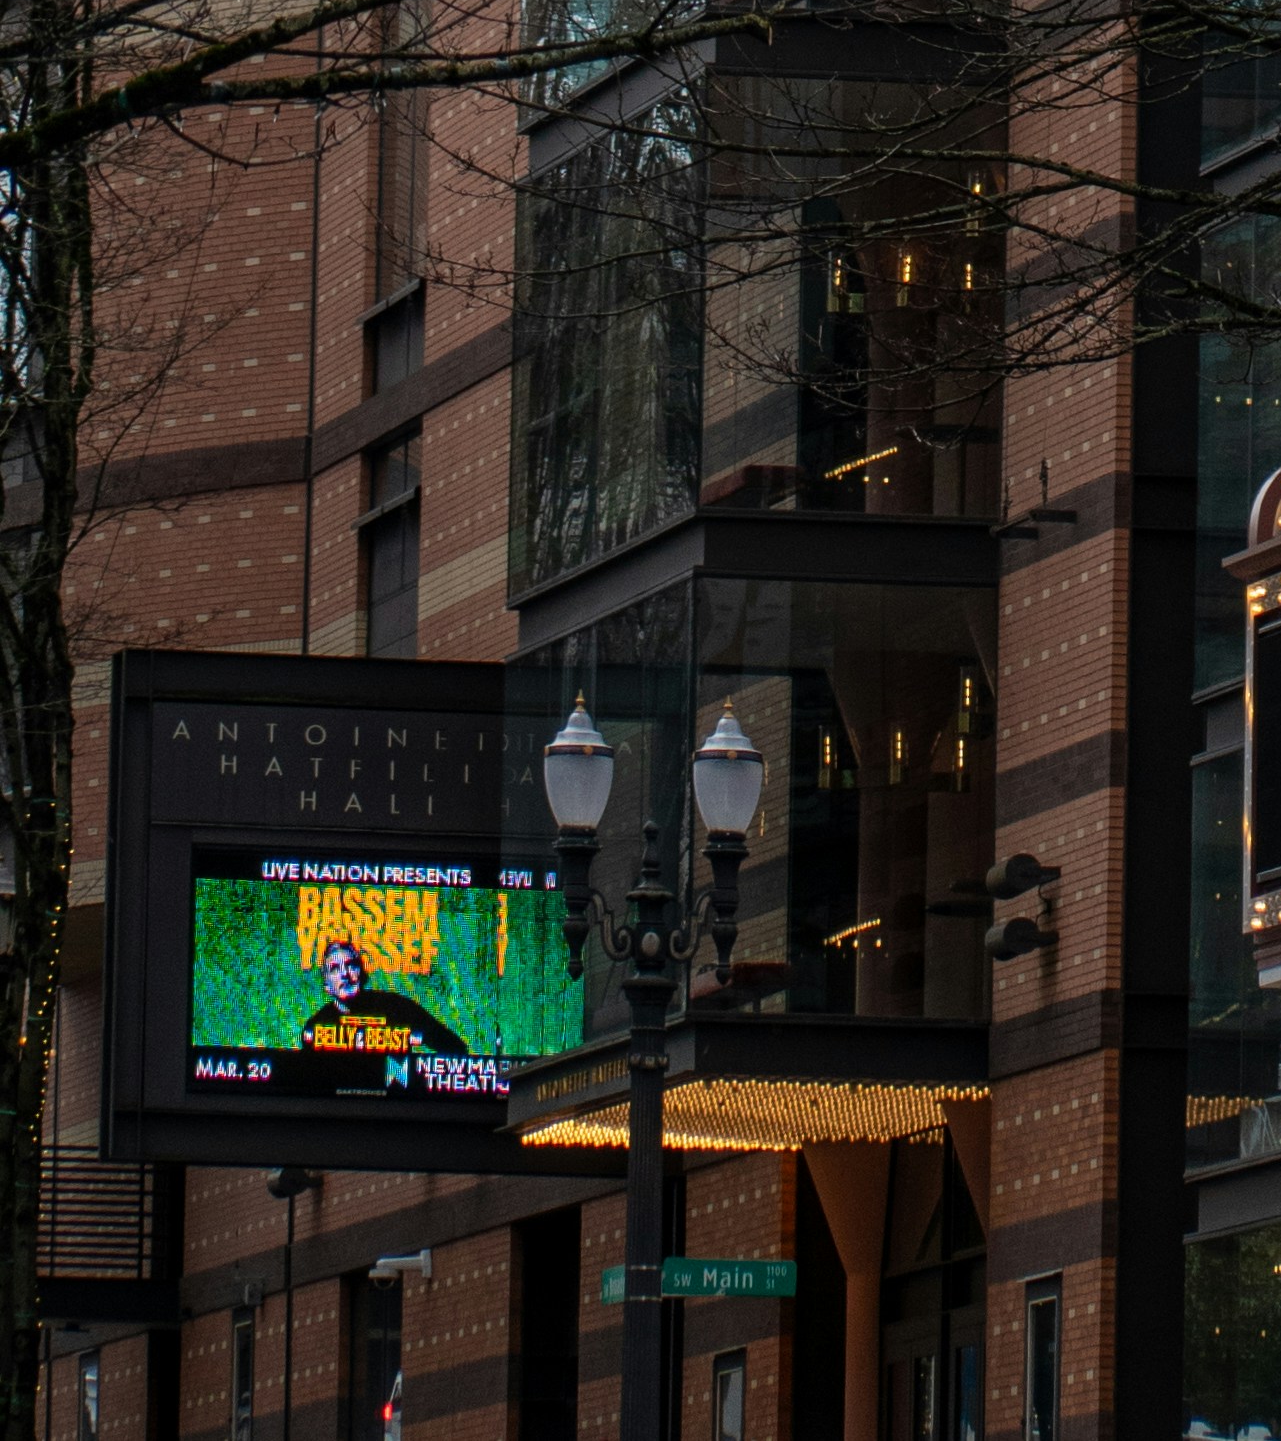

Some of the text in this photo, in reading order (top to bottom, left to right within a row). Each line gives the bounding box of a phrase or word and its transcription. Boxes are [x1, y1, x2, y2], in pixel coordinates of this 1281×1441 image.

[262, 861, 472, 886] LIVE NATION PRESENTS
[298, 886, 439, 932] BASSEM
[314, 1024, 356, 1051] BELLY
[365, 1026, 410, 1053] BEAST
[247, 1061, 272, 1081] 20
[673, 1267, 754, 1289] SW Main
[766, 1265, 788, 1277] 1100
